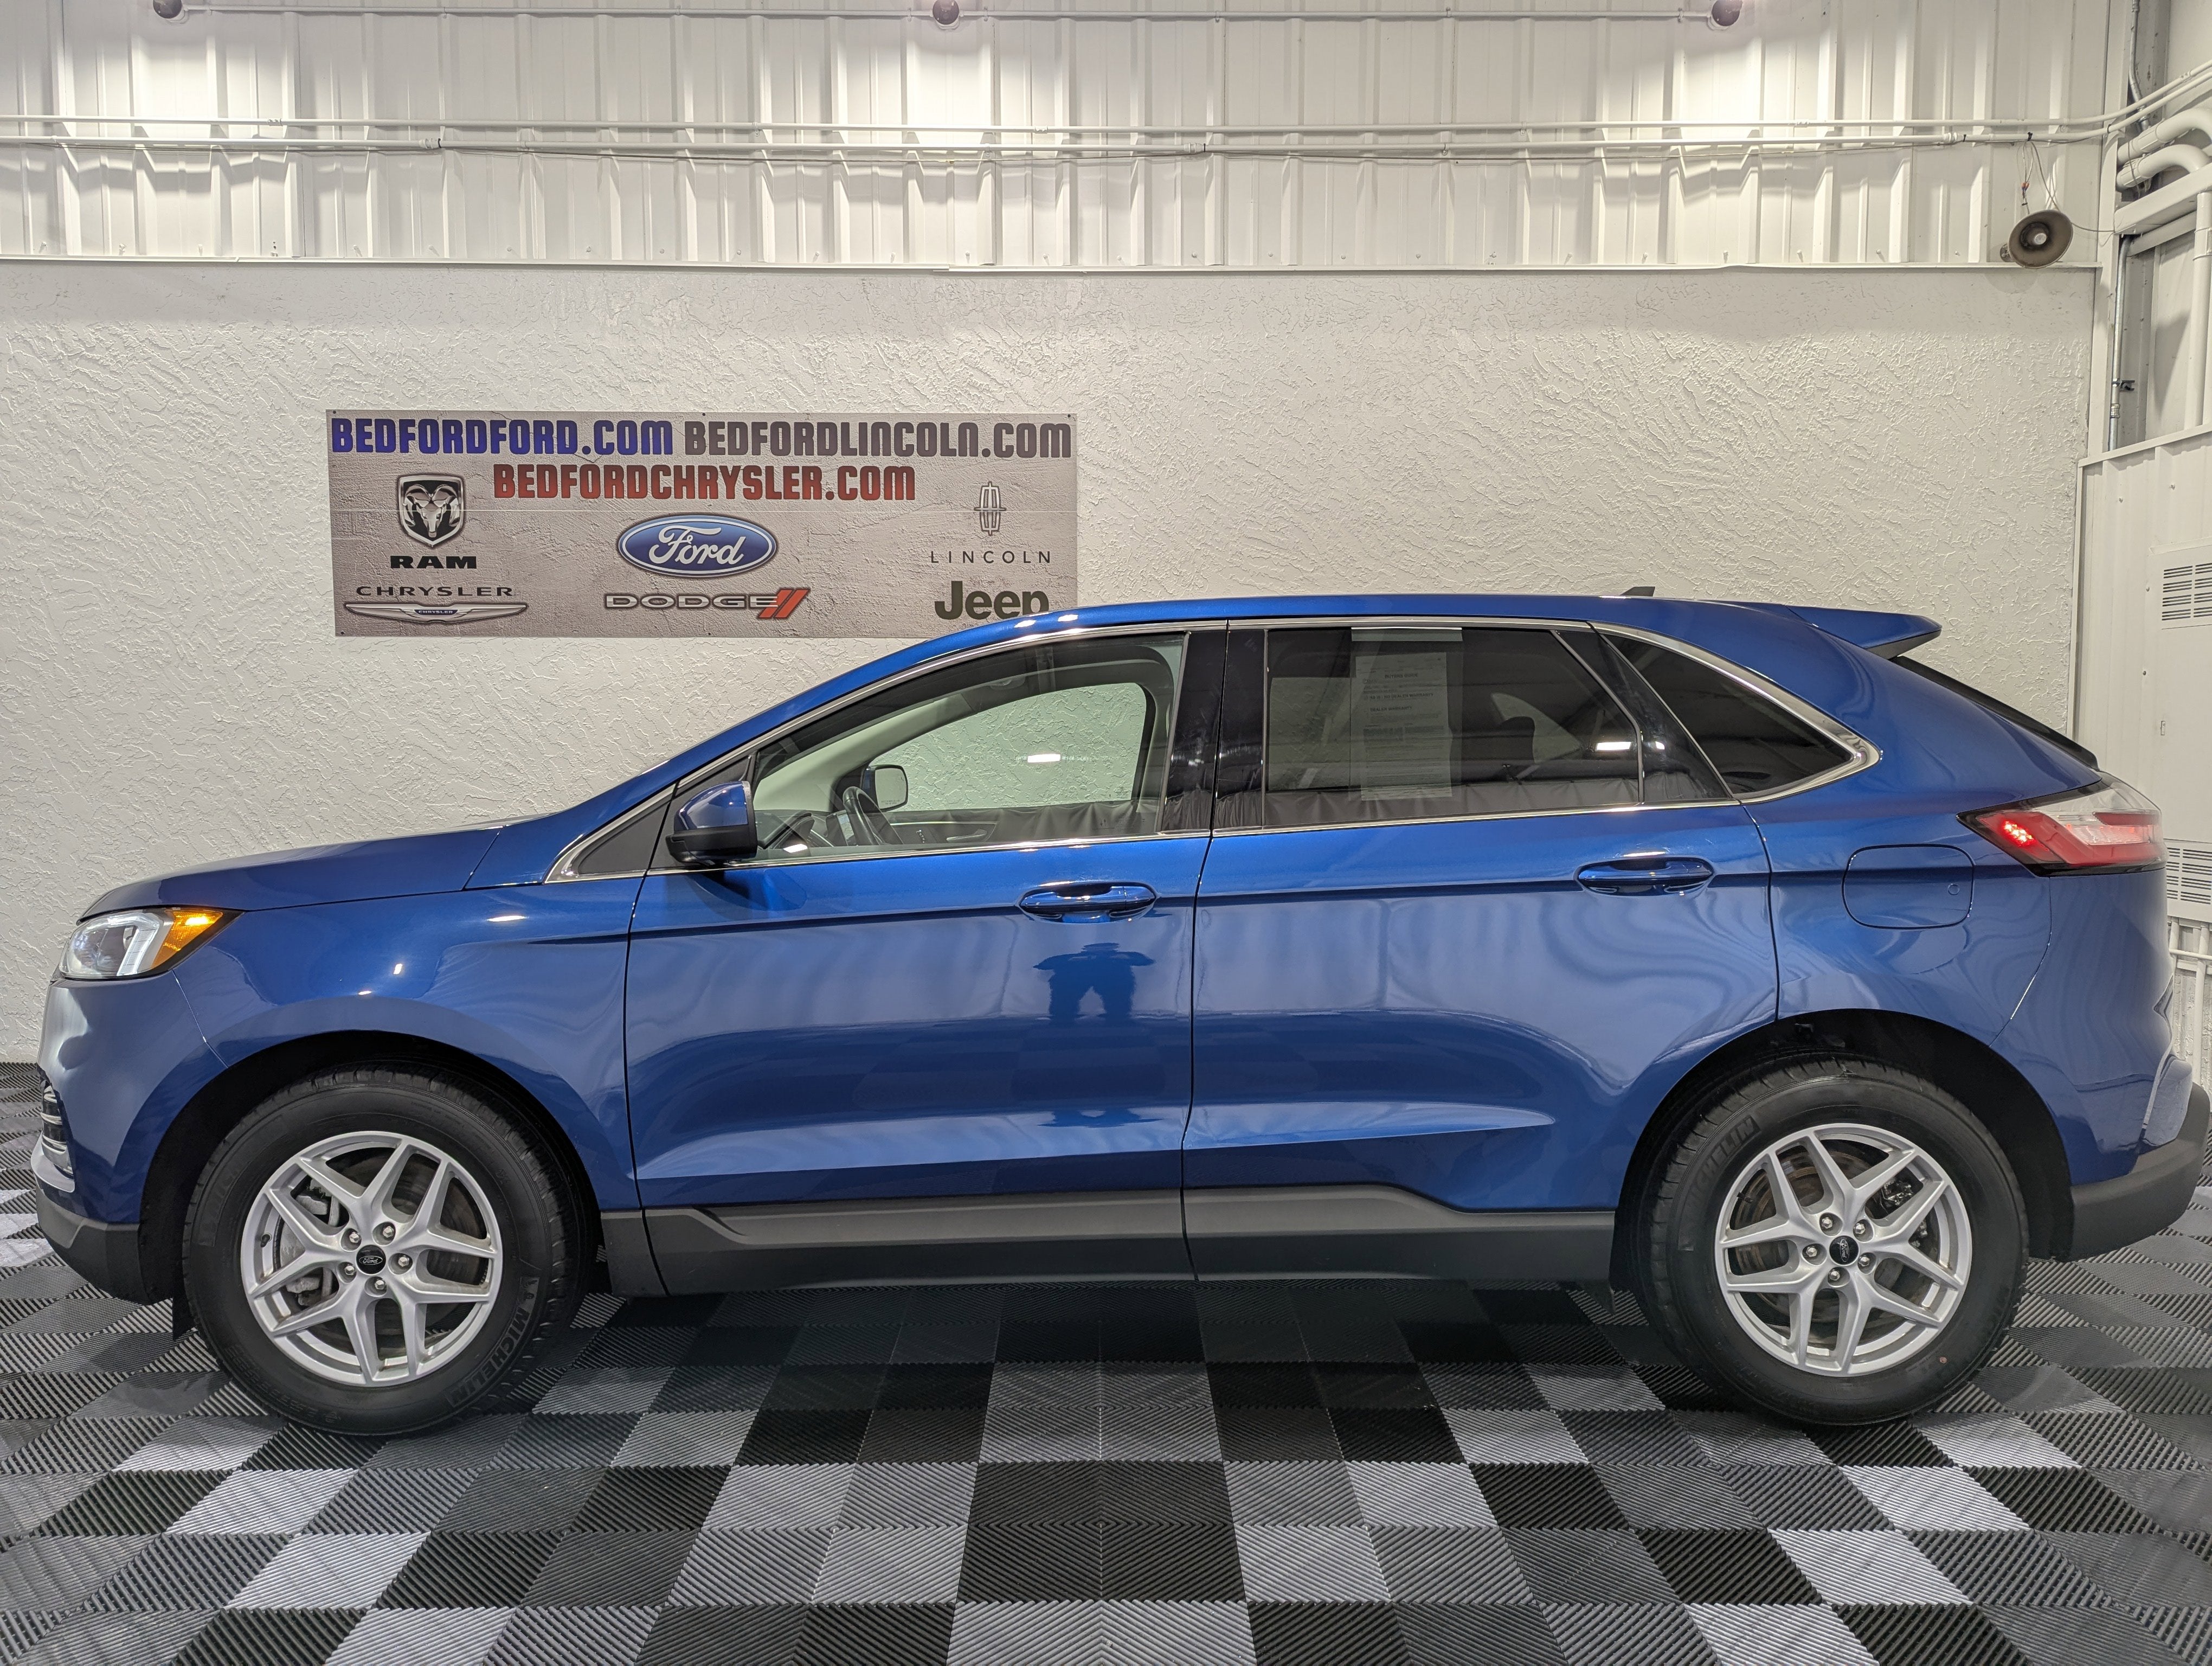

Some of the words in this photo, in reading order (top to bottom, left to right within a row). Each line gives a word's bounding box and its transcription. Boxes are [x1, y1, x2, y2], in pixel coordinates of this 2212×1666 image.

[331, 418, 673, 456] BEDFORDFORD.COM
[684, 420, 1071, 458] BEDFORDLINCOLN.COM
[493, 464, 916, 501] BEDFORDCHRYSLER.COM
[390, 555, 477, 569] RAM
[648, 524, 746, 565] Ford
[931, 550, 1050, 564] LINCOLN
[356, 586, 513, 597] CHRYSLER
[606, 595, 779, 608] DODGE
[934, 580, 1050, 620] Jeep
[451, 1306, 531, 1406] MICHELIN
